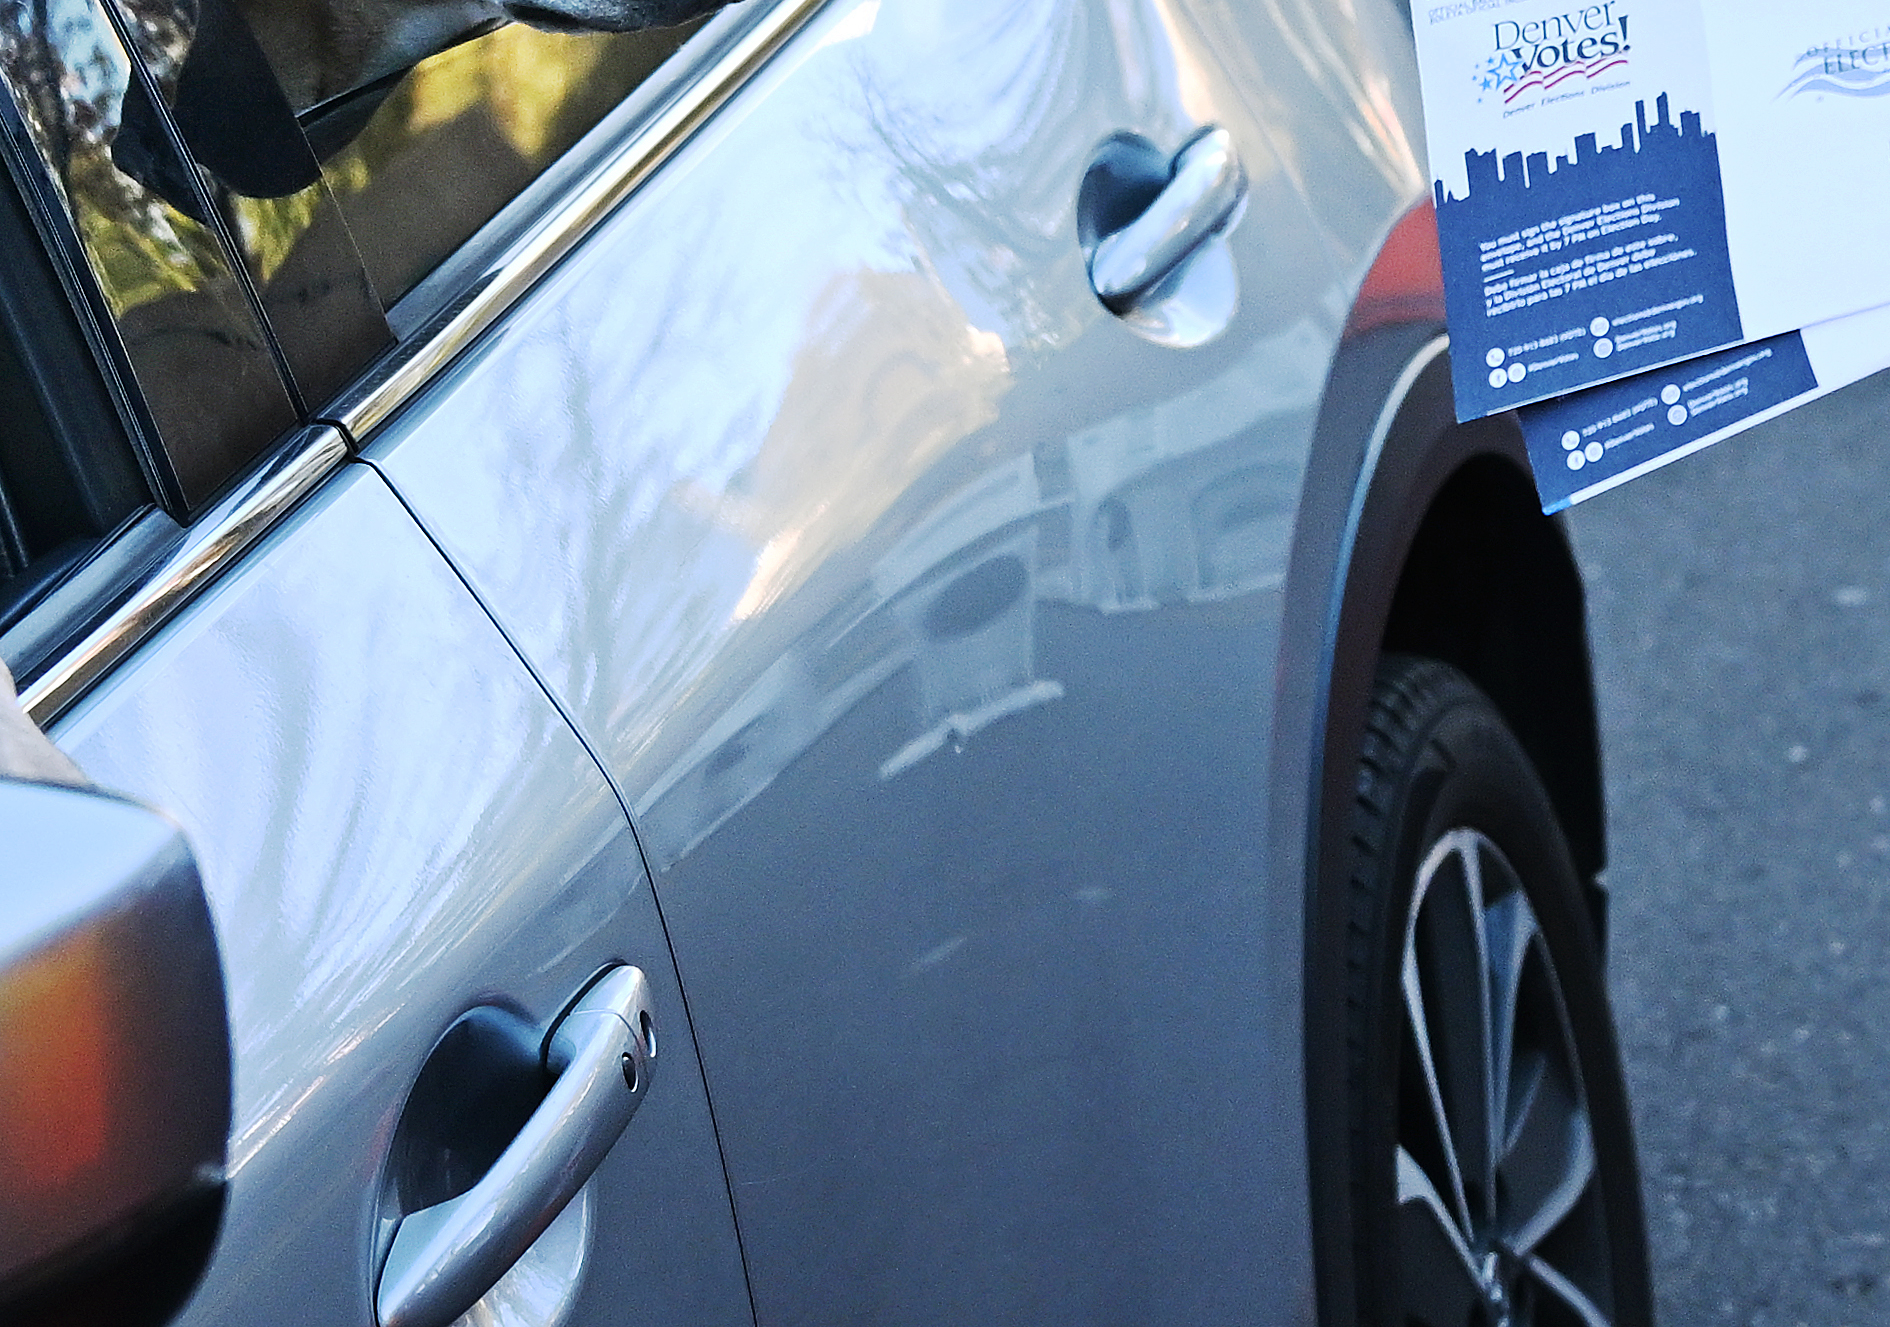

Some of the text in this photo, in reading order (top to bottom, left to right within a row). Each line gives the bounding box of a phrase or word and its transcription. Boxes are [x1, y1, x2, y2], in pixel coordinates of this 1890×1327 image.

[1428, 1, 1471, 17] OFFICIAL
[1493, 0, 1616, 51] Denver
[1511, 15, 1631, 73] Votes!
[1503, 103, 1535, 119] Denver
[1591, 81, 1631, 95] Division
